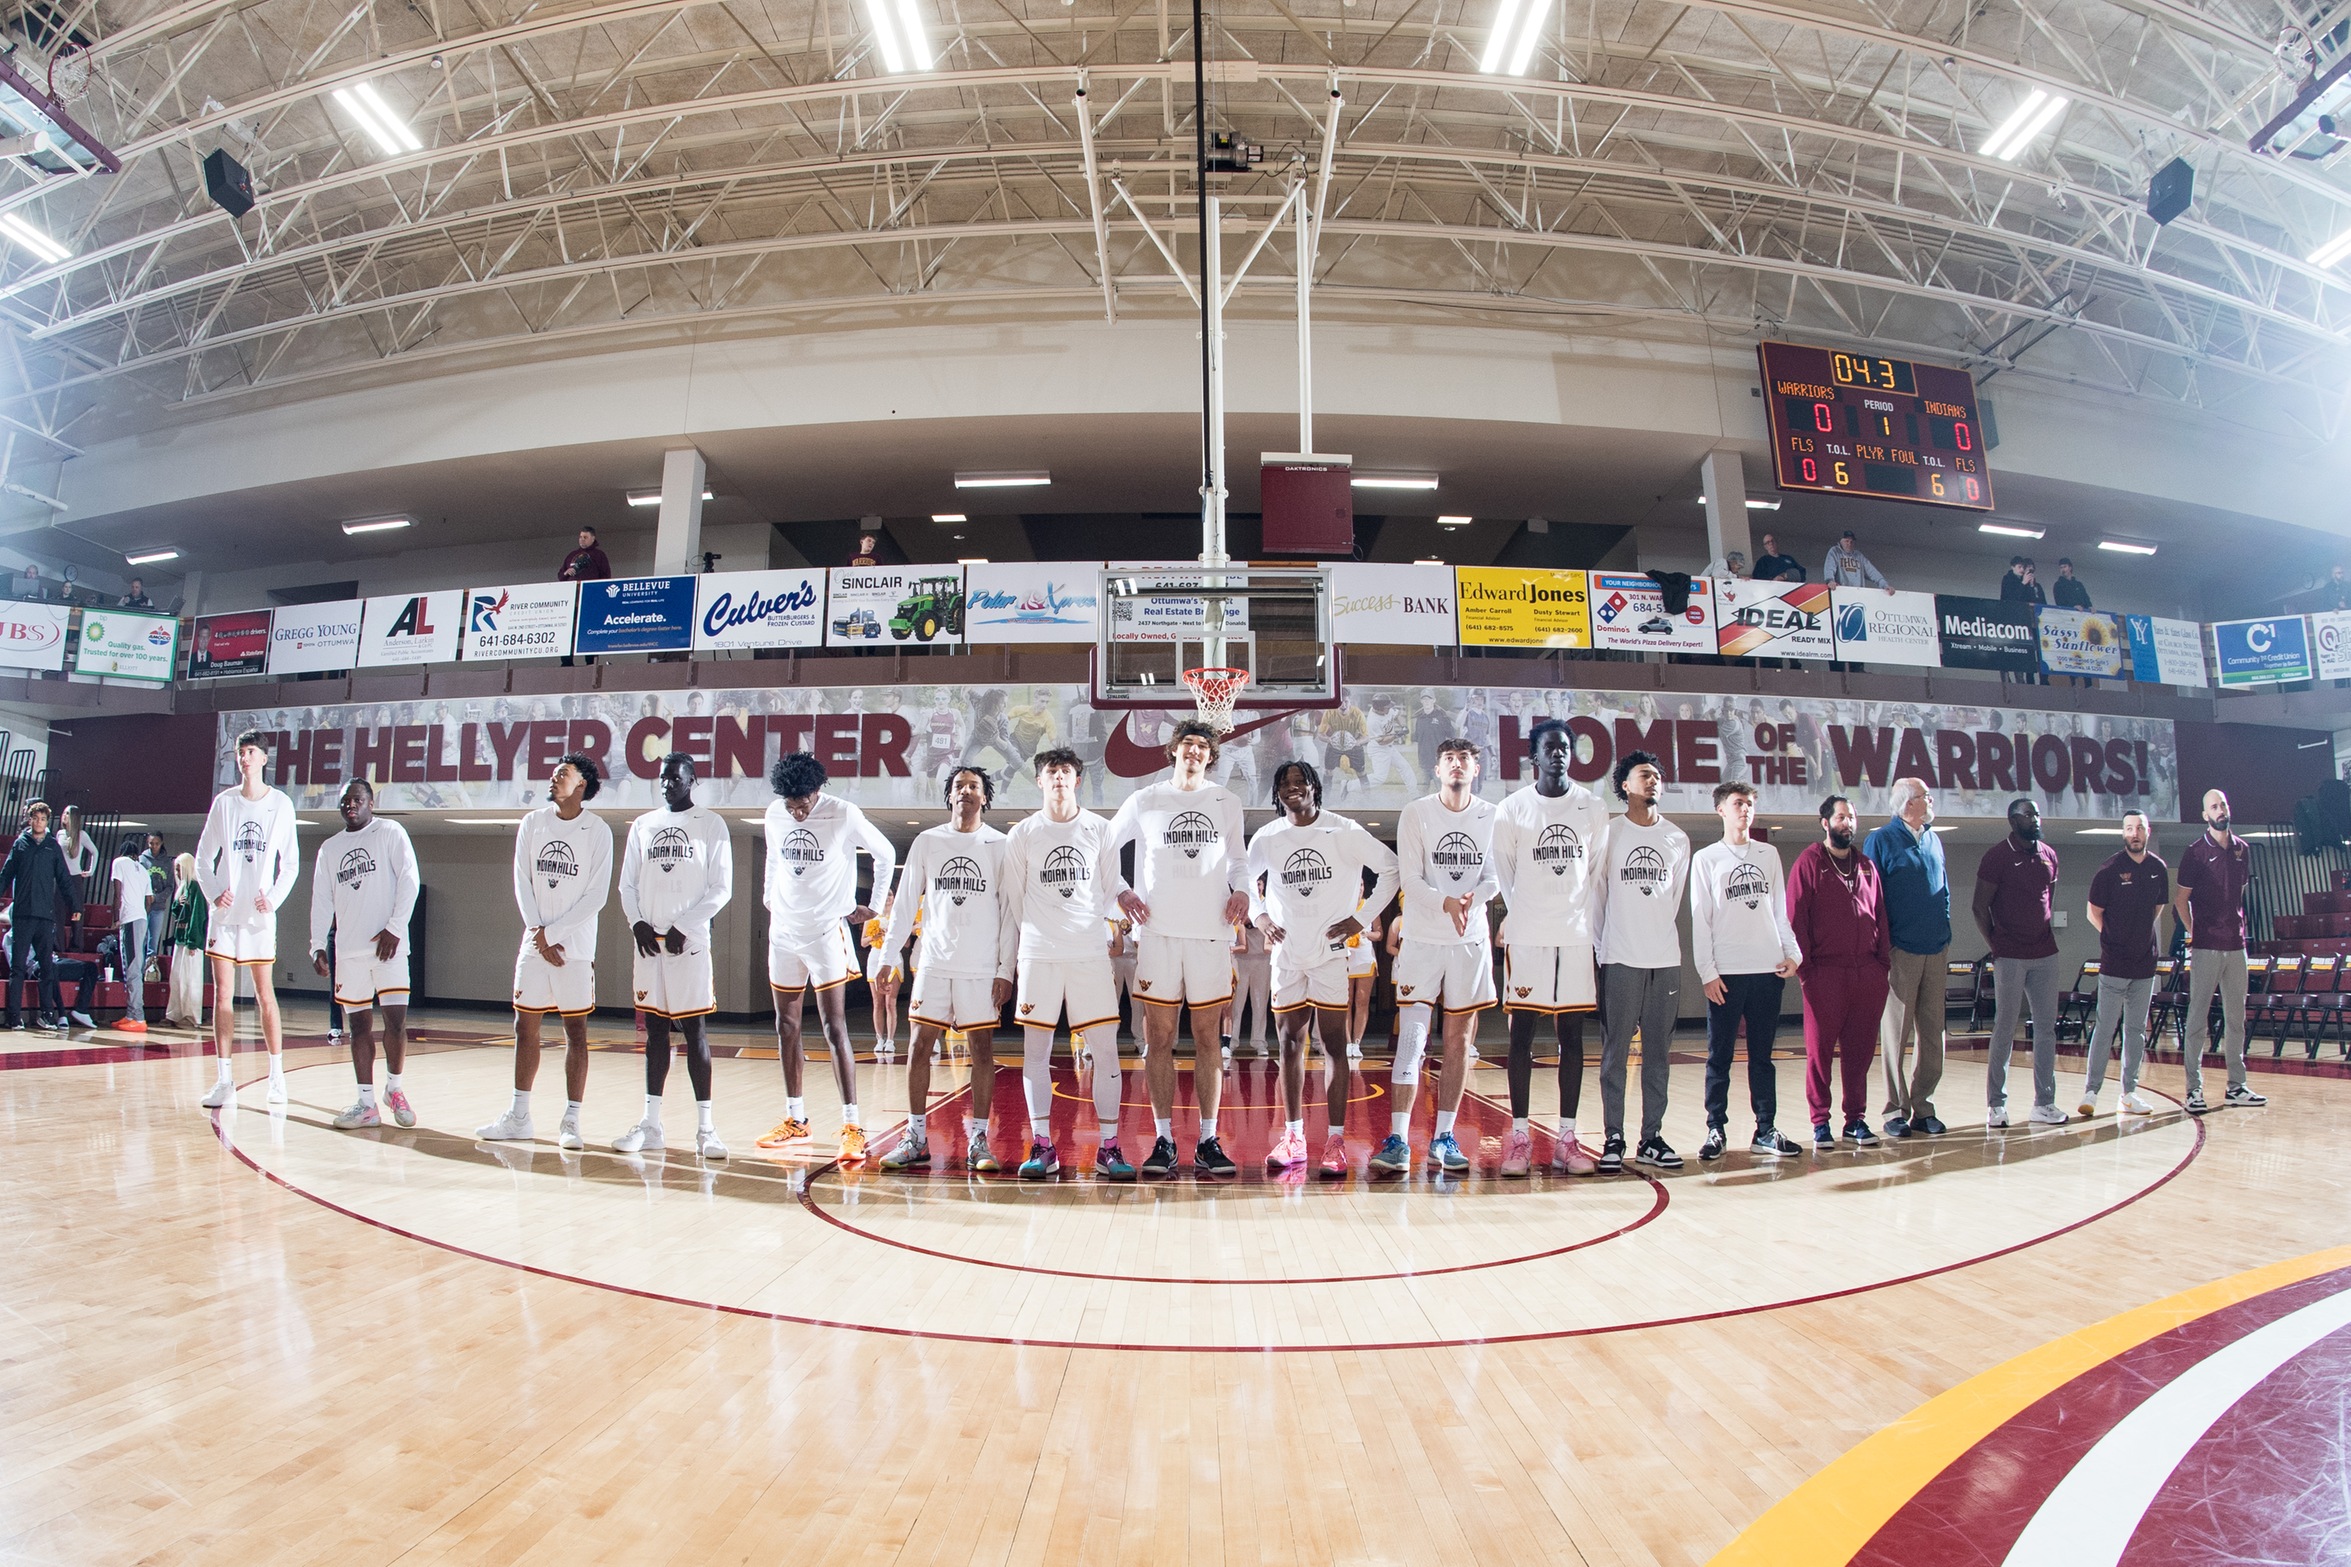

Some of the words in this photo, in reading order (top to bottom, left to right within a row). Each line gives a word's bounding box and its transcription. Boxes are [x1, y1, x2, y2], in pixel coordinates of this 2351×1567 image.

[1834, 353, 1895, 388] 04.3
[1777, 381, 1835, 400] WARRIORS
[1864, 399, 1894, 412] PERIOD
[1924, 401, 1967, 419] INDIANS
[1814, 404, 1832, 432] 0
[1883, 416, 1890, 436] 1
[1954, 423, 1972, 451] 0
[1791, 438, 1814, 453] FLS
[1826, 444, 1851, 455] T.O.L.
[1856, 444, 1885, 461] PLYR
[1891, 450, 1918, 465] FOUL
[1922, 455, 1945, 468] T.O.L.
[1802, 458, 1817, 482] 0
[1956, 458, 1975, 473] FLS
[1834, 462, 1849, 485] 6
[1931, 474, 1944, 496] 6
[1965, 477, 1979, 501] 0
[1840, 558, 1861, 570] IHCC
[623, 581, 670, 591] BELLEVUE
[842, 577, 902, 589] SINCLAIR
[967, 589, 1017, 609] Polar
[1460, 582, 1527, 600] Edward
[1529, 583, 1585, 603] Jones
[510, 602, 528, 610] RIVER
[530, 600, 569, 609] COMMUNITY
[703, 580, 817, 637] Culver's
[1334, 594, 1402, 617] Success
[1404, 596, 1449, 614] BANK
[604, 612, 666, 625] Accelerate.
[1737, 608, 1821, 630] IDEAL
[1875, 610, 1928, 625] OTTUMWA
[275, 627, 313, 641] GREGG
[317, 623, 357, 637] YOUNG
[1597, 625, 1630, 633] Domino's
[1869, 623, 1936, 637] REGIONAL
[1945, 615, 2030, 640] Mediacom
[2043, 624, 2080, 639] Sassy
[108, 641, 131, 650] Quality
[317, 639, 354, 647] OTTUMWA
[383, 638, 413, 647] Anderson,
[414, 636, 434, 644] Larkin
[479, 631, 556, 647] 641-684-6302
[1906, 637, 1929, 645] CENTER
[2054, 638, 2117, 654] Sunflower
[84, 648, 107, 656] Trusted
[474, 646, 559, 657] RIVERCOMMUNITYCU.ORG
[1951, 642, 1972, 650] Xtream
[2004, 646, 2028, 654] Business
[2228, 656, 2259, 664] Community
[934, 736, 949, 745] 491
[1754, 722, 1797, 752] OF
[266, 728, 343, 787] THE
[352, 720, 612, 785] HELLYER
[625, 713, 913, 780] CENTER
[1501, 716, 1722, 783] HOME
[1828, 724, 2149, 796] WARRIORS!
[1746, 755, 1807, 785] THE
[1163, 831, 1193, 844] INDIAN
[1196, 831, 1218, 843] HILLS
[672, 845, 693, 858] HILLS
[803, 849, 824, 861] HILLS
[1432, 852, 1458, 864] INDIAN
[1460, 853, 1482, 865] HILLS
[1533, 846, 1559, 861] INDIAN
[357, 859, 376, 876] HILLS
[557, 861, 578, 876] HILLS
[1621, 868, 1649, 880] INDIAN
[1040, 869, 1067, 883] INDIAN
[1070, 868, 1090, 880] HILLS
[1281, 870, 1307, 884] INDIAN
[1309, 867, 1332, 880] HILLS
[935, 877, 961, 891] INDIAN
[963, 877, 986, 892] HILLS
[1725, 884, 1750, 900] INDIAN
